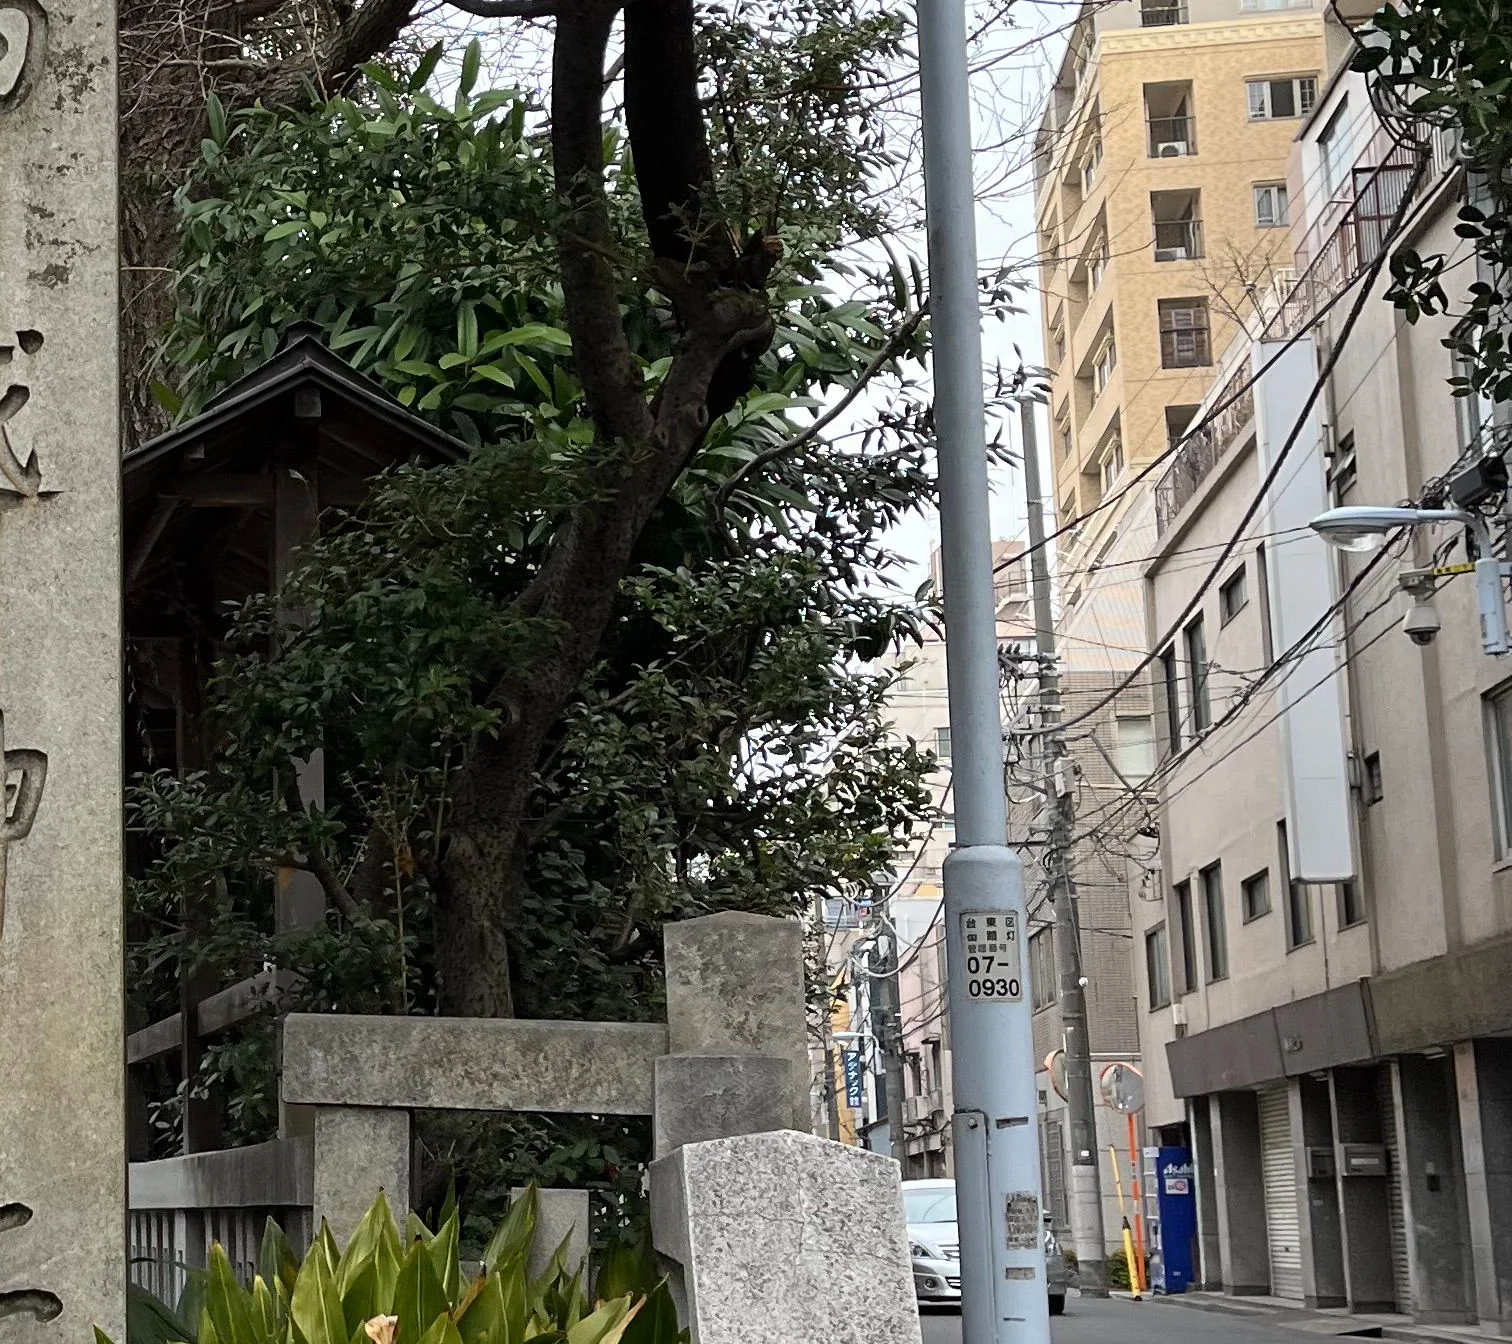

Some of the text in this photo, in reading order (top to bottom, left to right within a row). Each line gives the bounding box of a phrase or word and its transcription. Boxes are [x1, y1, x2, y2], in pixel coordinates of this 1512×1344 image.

[966, 917, 1015, 928] 台東区
[968, 956, 1009, 974] 07-
[969, 978, 1019, 997] 0930
